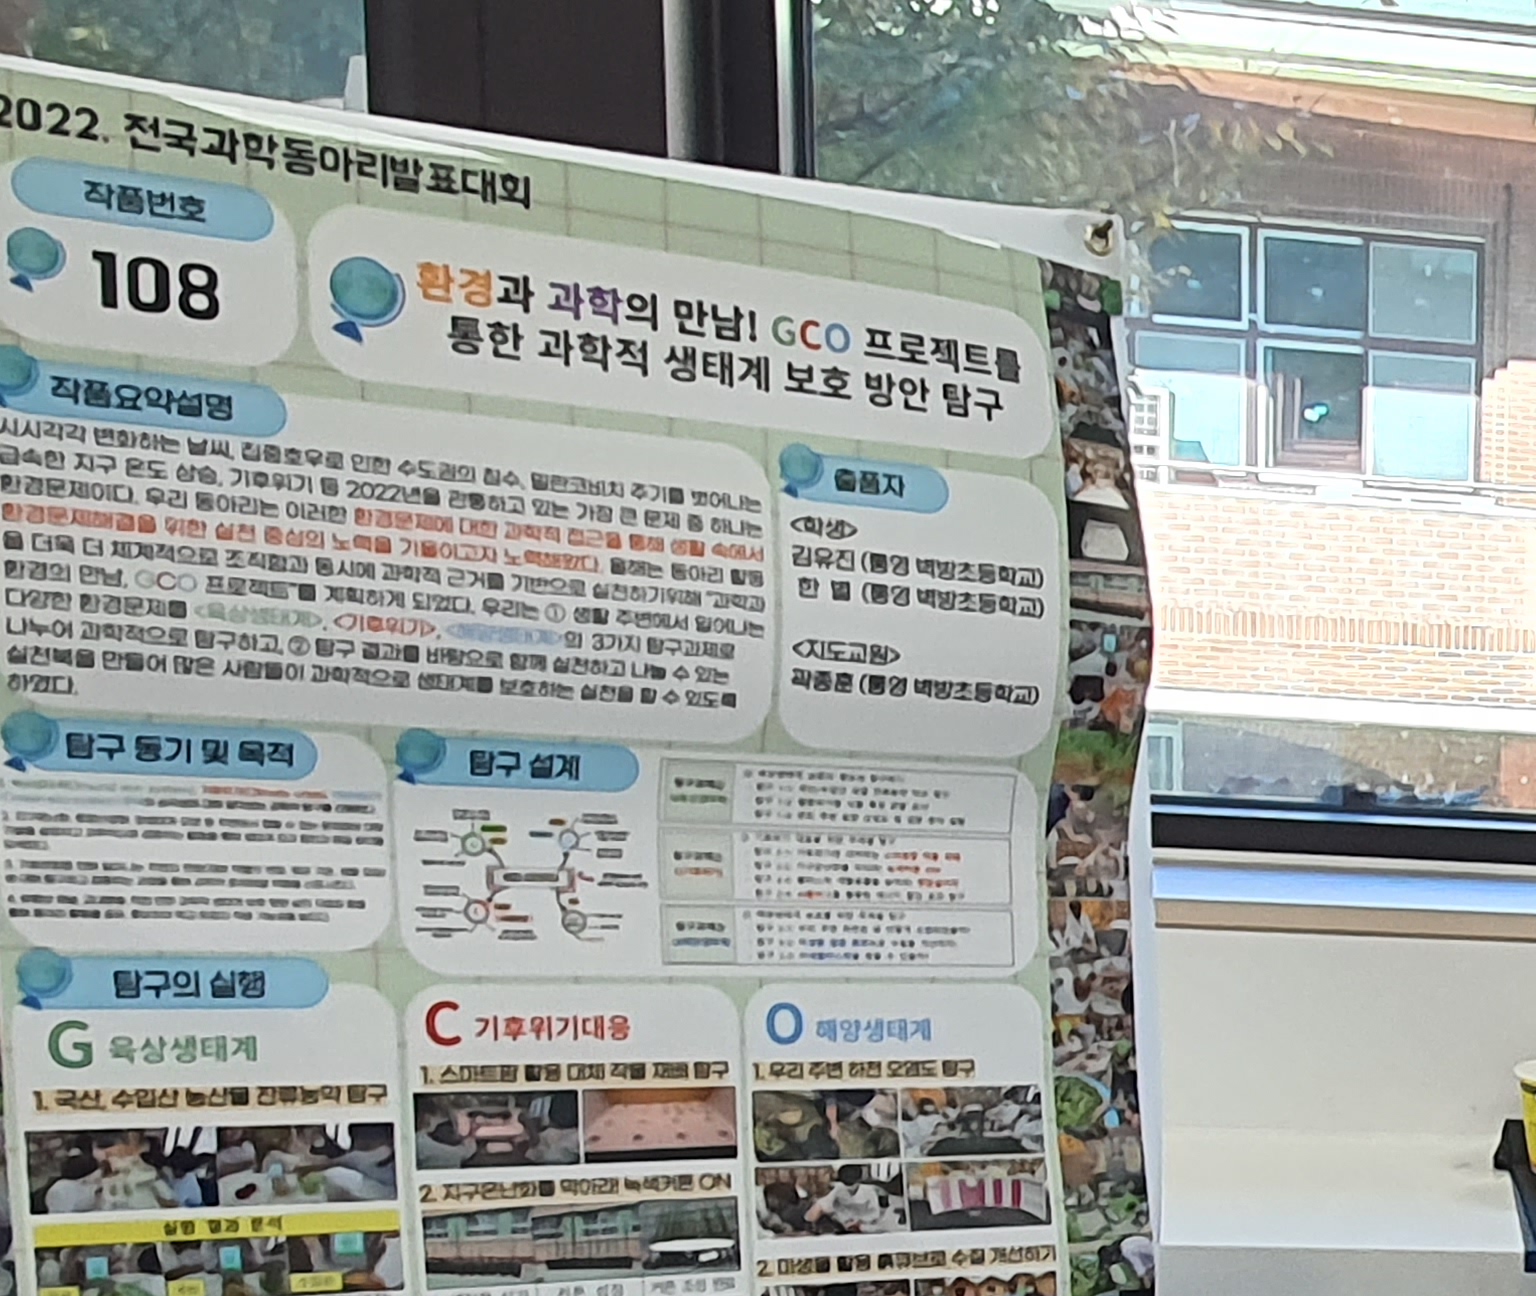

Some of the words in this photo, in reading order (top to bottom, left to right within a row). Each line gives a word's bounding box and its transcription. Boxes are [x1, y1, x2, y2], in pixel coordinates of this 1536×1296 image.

[124, 112, 531, 208] 전국과학동아리발표대회
[83, 180, 206, 223] 작품번호
[91, 251, 220, 320] 108
[417, 262, 534, 313] 환경과
[547, 282, 658, 331] 과학의
[674, 300, 757, 343] 만남!
[772, 318, 851, 353] GCO
[864, 328, 1022, 384] 프로젝트를
[448, 316, 523, 360] 통한
[538, 330, 649, 376] 과학적
[664, 346, 771, 393] 생태계
[784, 361, 852, 401] 보호
[864, 373, 930, 419] 방안
[942, 385, 1003, 424] 탐구
[51, 375, 234, 421] 작품요약설명
[95, 427, 180, 454] 변화하는
[834, 467, 904, 499] 출품자
[792, 544, 856, 571] 김유진
[798, 577, 819, 599] 한
[66, 732, 125, 761] 탐구
[135, 734, 192, 764] 동기
[201, 739, 229, 765] 및
[239, 740, 294, 766] 목적
[469, 750, 520, 777] 탐구
[529, 753, 580, 781] 설계
[113, 970, 200, 998] 탐구의
[210, 970, 265, 998] 실행
[48, 1020, 94, 1068] G
[109, 1035, 258, 1064] 육상생태계
[426, 1001, 461, 1046] C
[475, 1014, 631, 1040] 기후위기대응
[767, 1002, 803, 1045] O
[815, 1018, 931, 1042] 해양생태계
[421, 1066, 433, 1084] 1.
